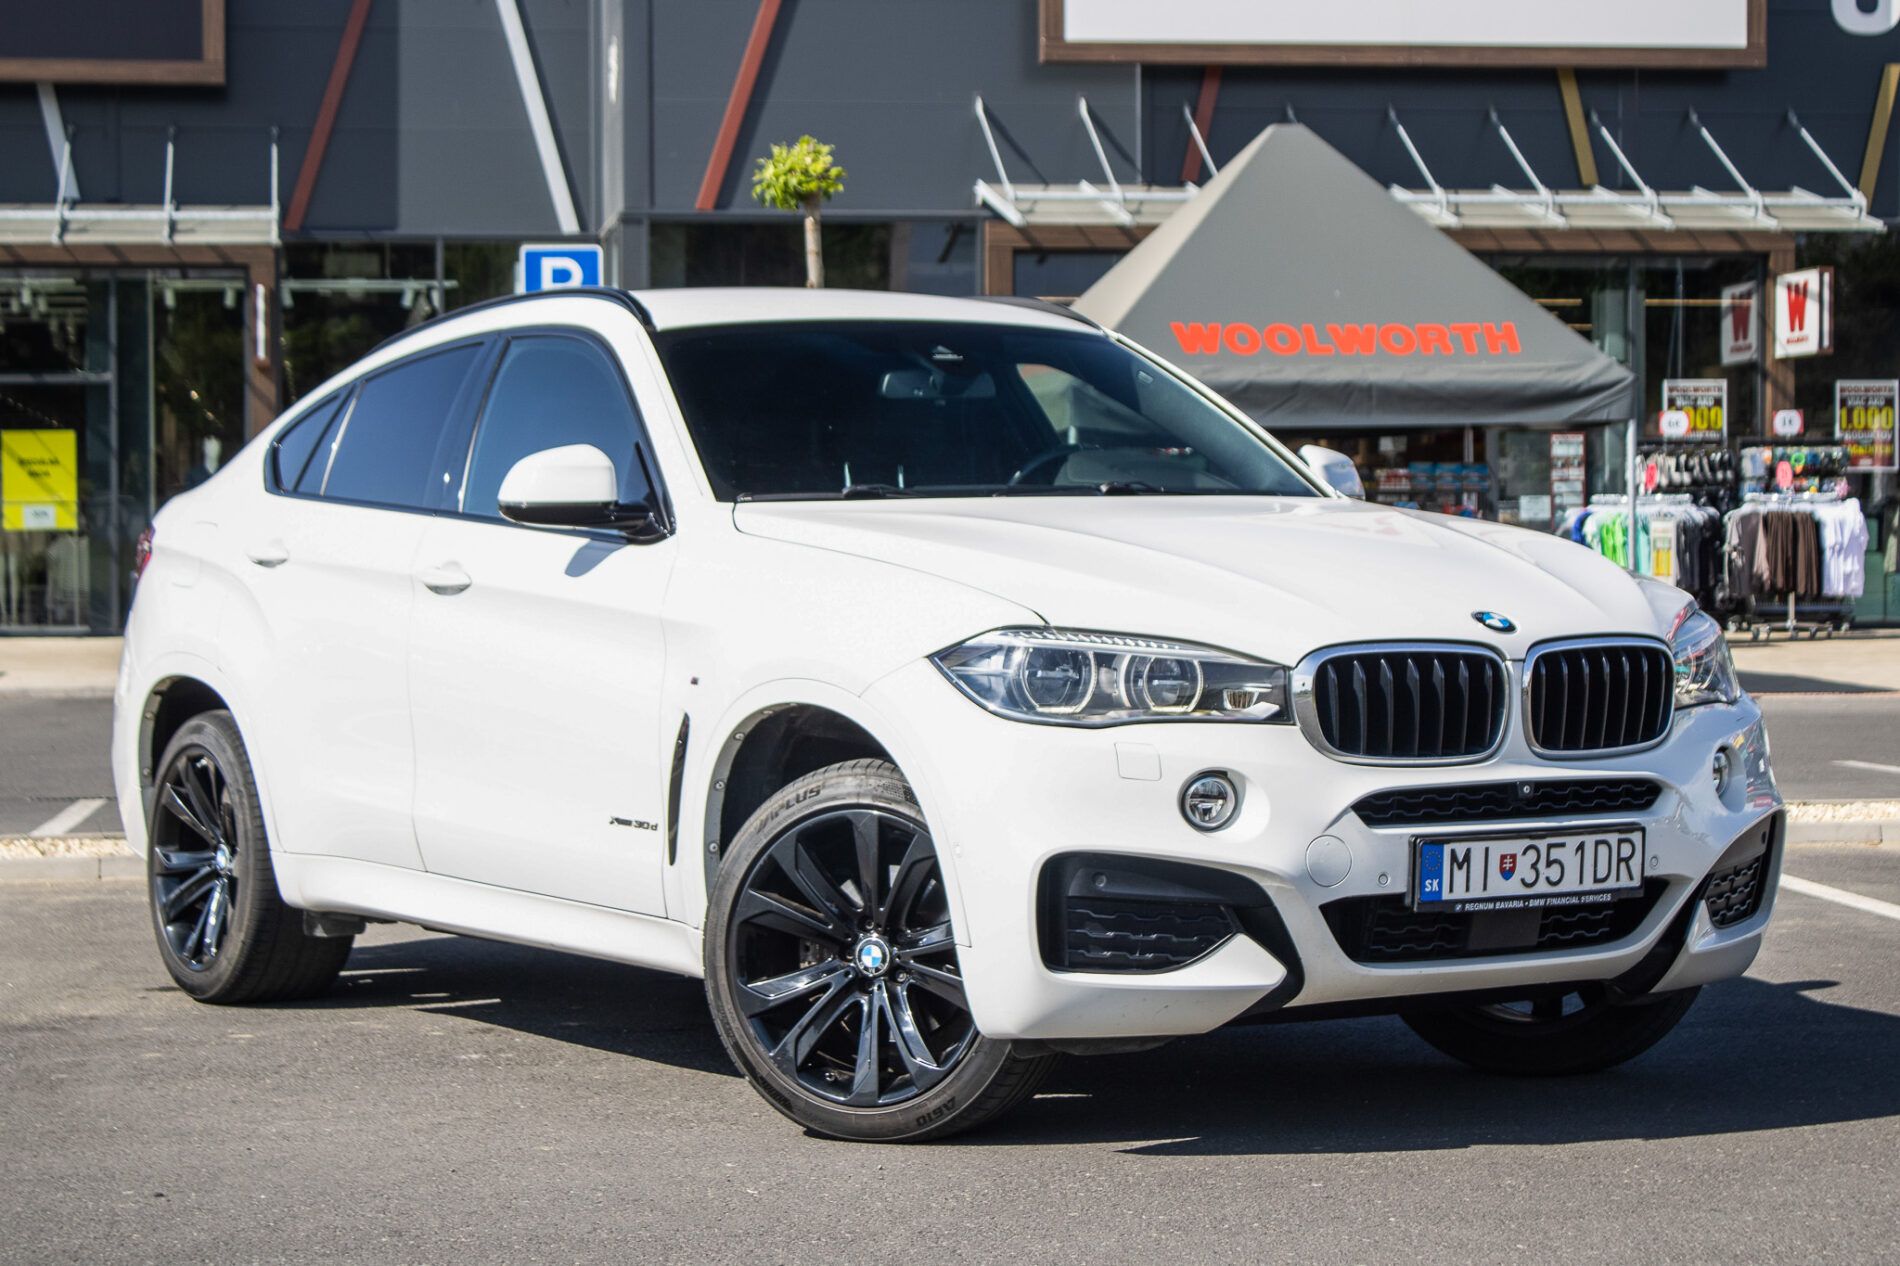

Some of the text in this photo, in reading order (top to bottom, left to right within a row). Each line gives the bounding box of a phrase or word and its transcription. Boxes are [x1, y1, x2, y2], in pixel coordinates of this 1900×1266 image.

[541, 256, 584, 291] P
[1786, 279, 1809, 332] W
[1169, 321, 1522, 357] WOOLWORTH
[1449, 837, 1637, 894] MI 351DR
[1424, 878, 1440, 893] SK
[1465, 902, 1495, 911] REGNUM
[1495, 900, 1524, 909] BAVARIA
[1546, 896, 1580, 906] FINANCIAL
